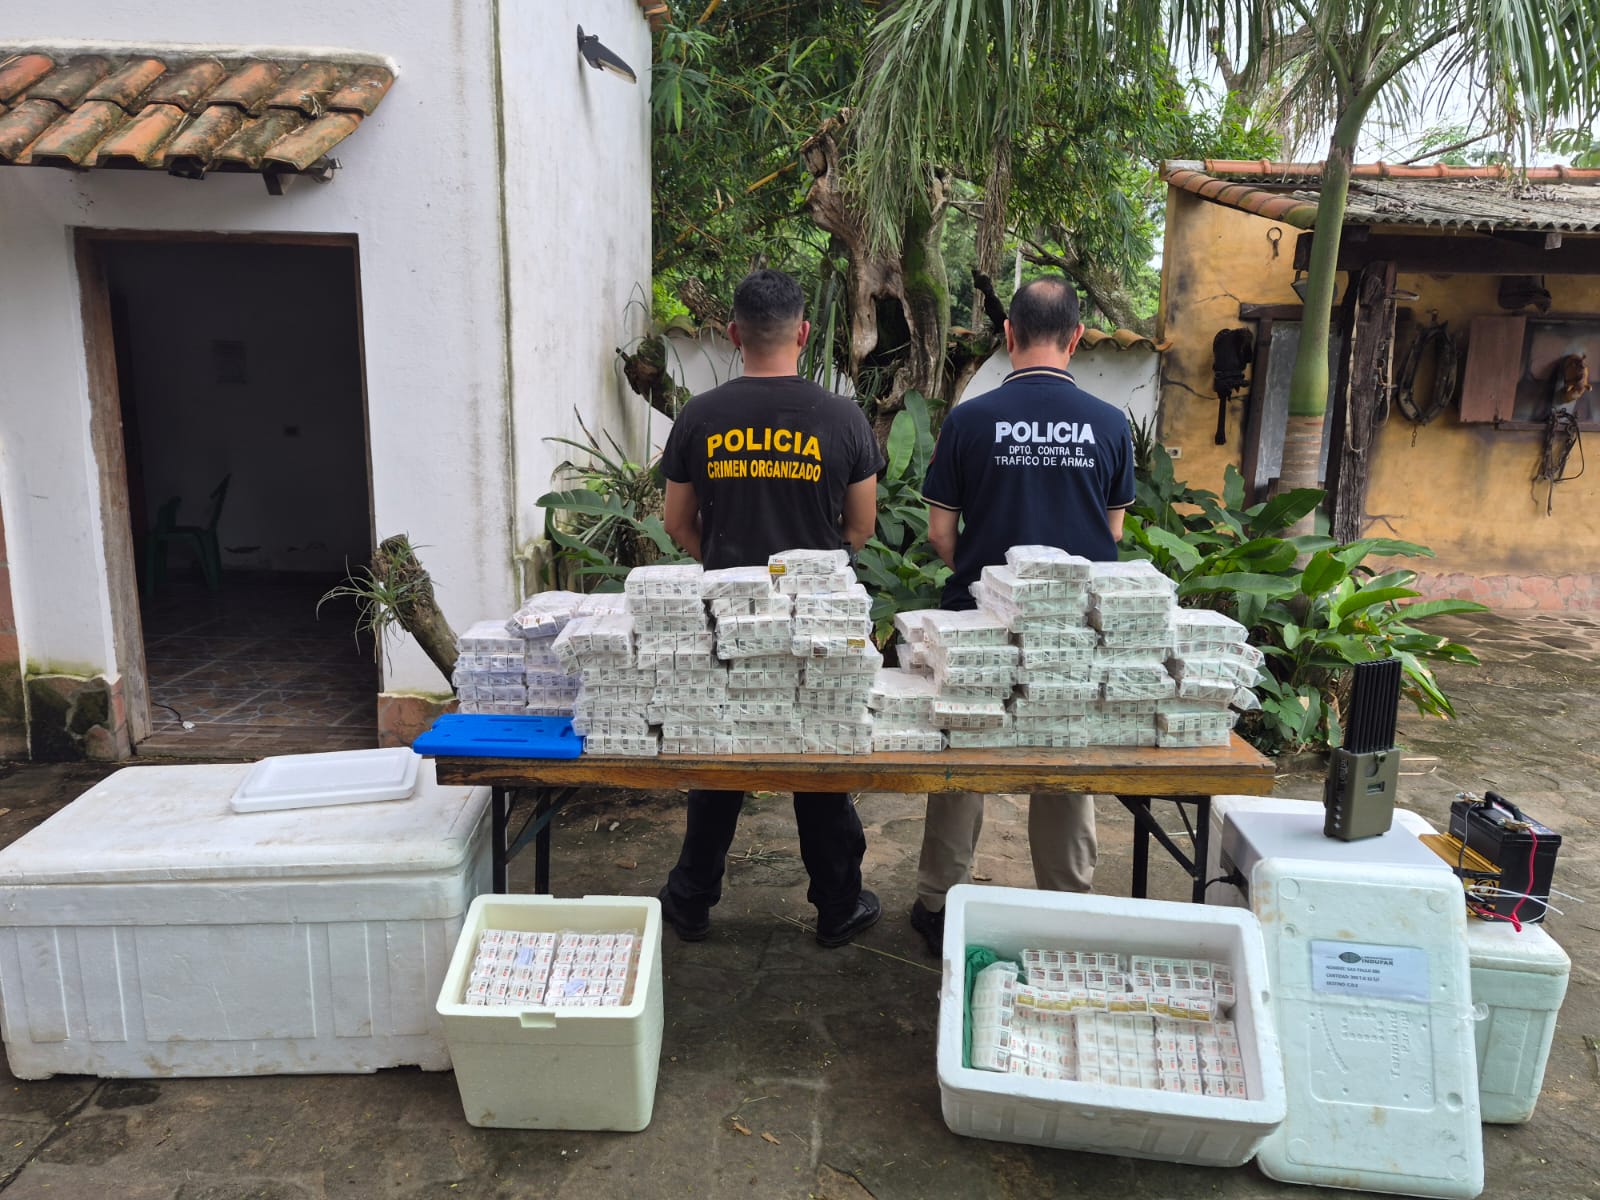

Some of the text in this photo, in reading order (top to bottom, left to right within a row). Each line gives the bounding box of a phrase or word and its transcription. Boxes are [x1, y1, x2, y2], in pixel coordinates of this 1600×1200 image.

[707, 427, 822, 461] POLICIA
[995, 421, 1095, 444] POLICIA
[994, 455, 1095, 468] TRAFICO DE ARMAS
[1037, 446, 1070, 456] CONTRA
[1075, 447, 1085, 456] EL
[707, 459, 822, 482] CRIMEN ORGANIZADO
